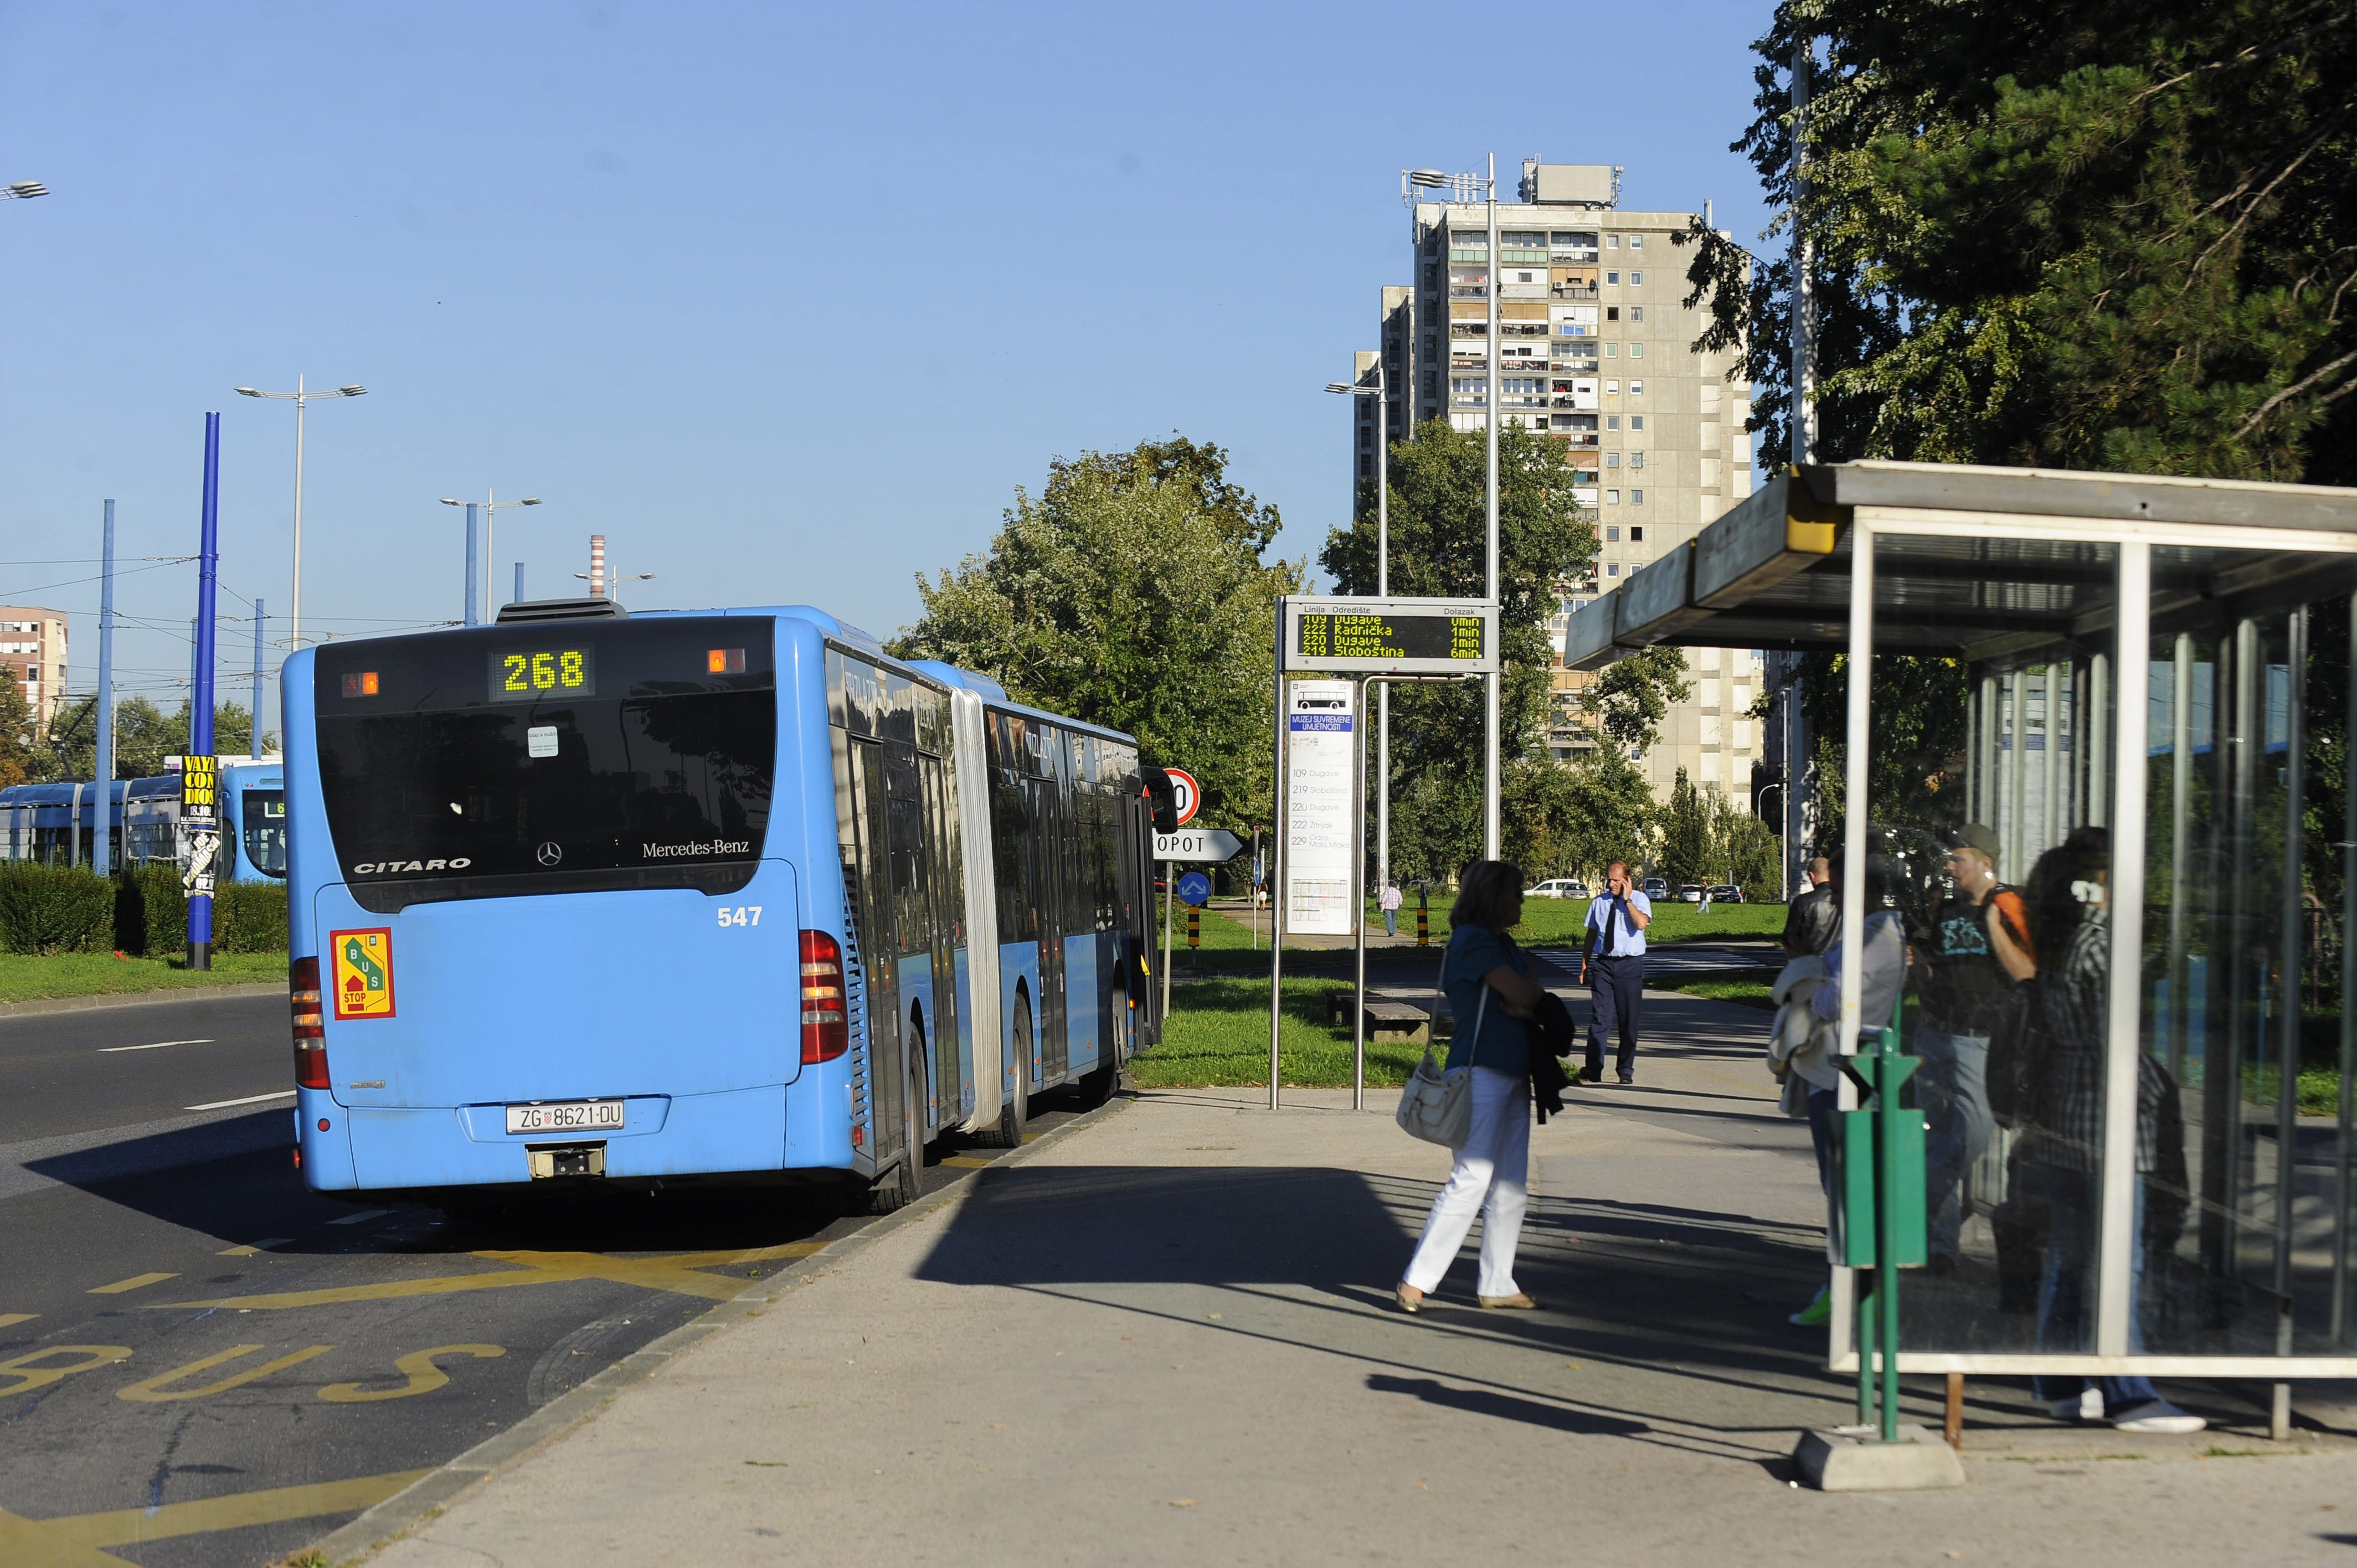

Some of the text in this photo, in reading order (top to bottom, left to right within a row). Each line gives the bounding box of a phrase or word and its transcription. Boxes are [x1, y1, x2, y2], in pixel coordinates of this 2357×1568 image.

[1304, 606, 1325, 614] Linija
[1304, 624, 1479, 637] 222 Radnička 1min
[1303, 635, 1479, 648] 220 Dugave 1min
[1303, 646, 1479, 658] 219 Sloboština 6min
[504, 651, 583, 691] 268
[1313, 715, 1351, 724] SUVREMENE
[184, 756, 215, 772] VAYA
[185, 772, 214, 788] CON
[1293, 769, 1307, 777] 109
[184, 788, 214, 805] DIOS
[1293, 785, 1308, 793] 219
[1292, 821, 1307, 829] 222
[193, 832, 210, 851] JOE
[643, 839, 749, 858] Mercedes-Benz
[1152, 837, 1204, 852] OPOT
[1291, 837, 1306, 845] 229
[354, 858, 471, 874] CITARO
[717, 906, 762, 927] 547
[344, 993, 366, 1003] STOP
[521, 1110, 541, 1127] ZG
[0, 1344, 506, 1402] BUS
